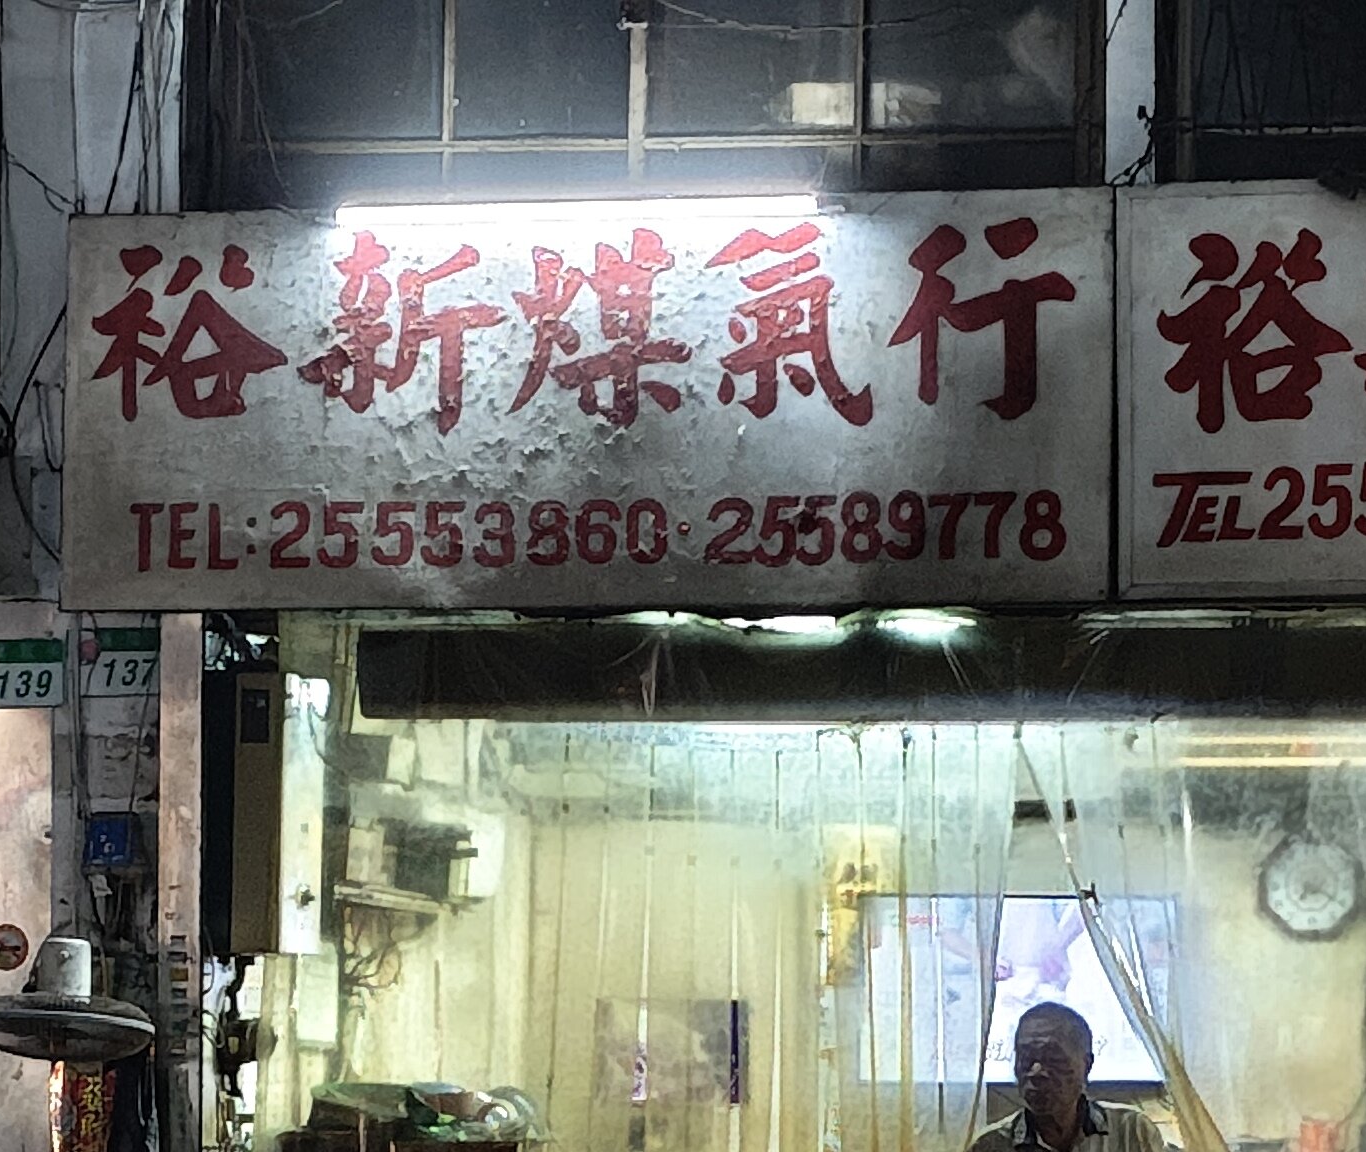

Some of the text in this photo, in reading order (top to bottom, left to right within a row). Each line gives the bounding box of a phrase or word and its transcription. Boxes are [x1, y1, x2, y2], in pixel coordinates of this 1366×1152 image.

[92, 217, 1076, 434] 裕新煤氣行
[103, 658, 158, 688] 137
